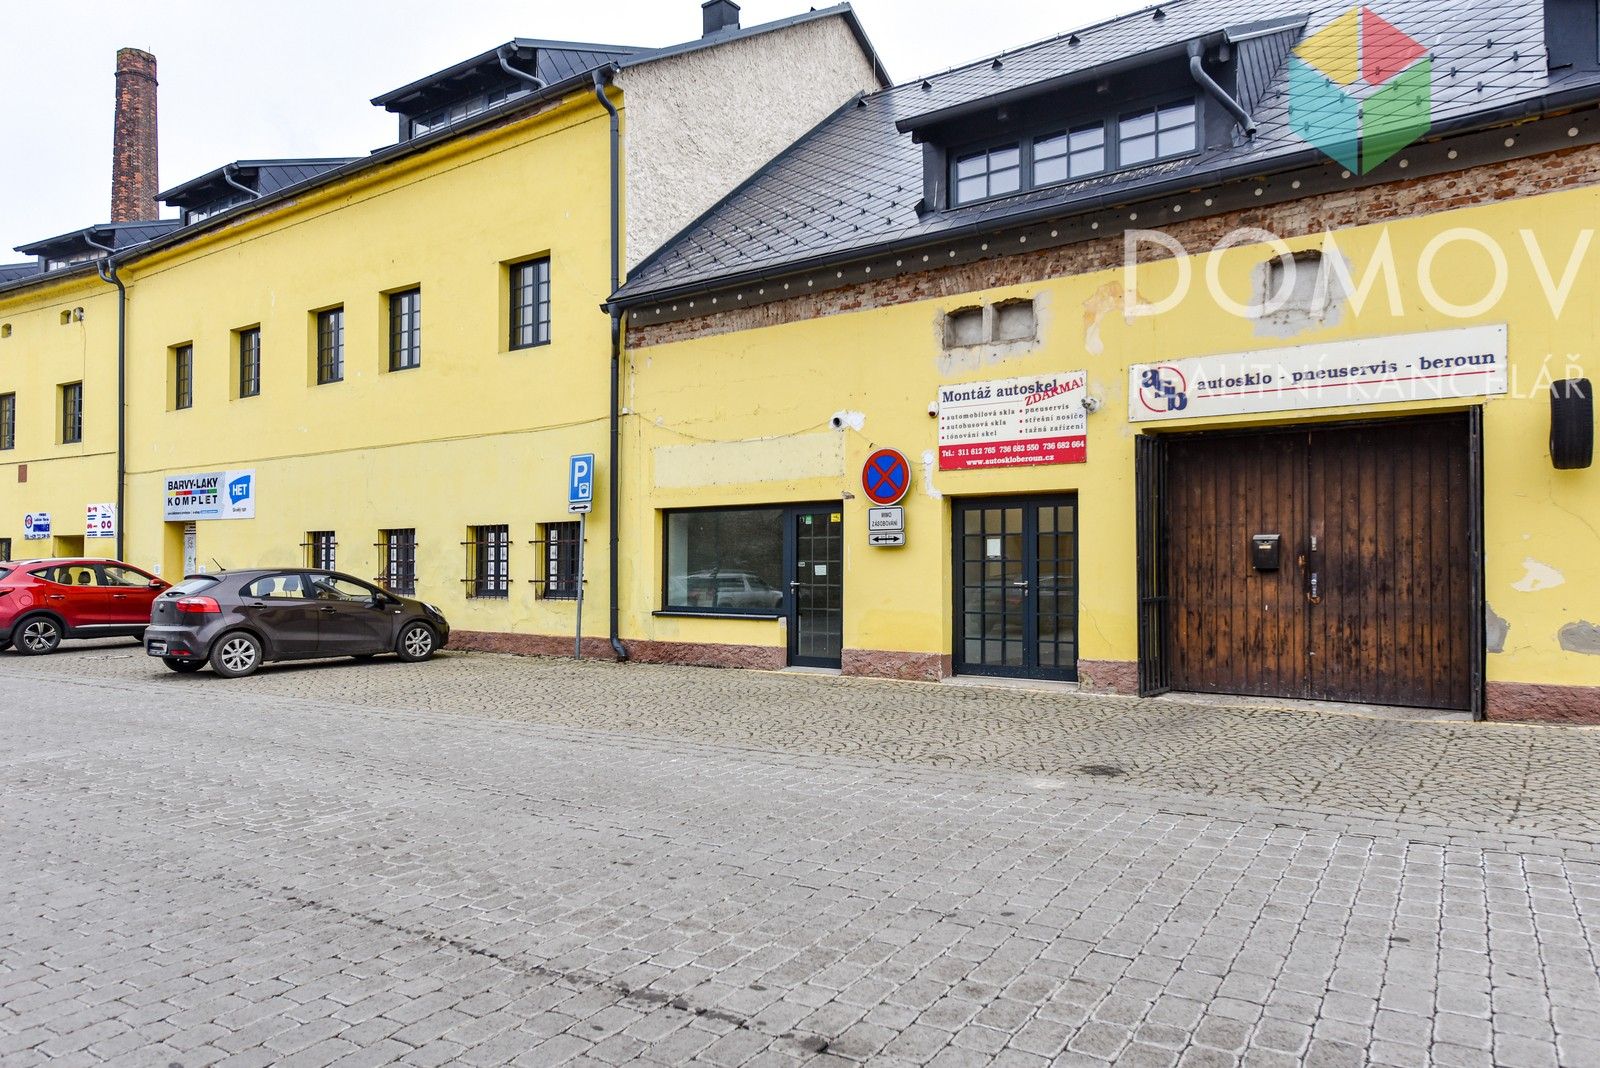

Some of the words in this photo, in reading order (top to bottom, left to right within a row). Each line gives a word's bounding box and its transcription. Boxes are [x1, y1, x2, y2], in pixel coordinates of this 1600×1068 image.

[1197, 370, 1272, 390] autosklo
[1292, 360, 1398, 386] pneuservis
[1420, 350, 1496, 370] beroun
[942, 386, 991, 403] Montáž
[996, 379, 1057, 397] autoskel
[1025, 377, 1084, 406] ZDARMA!
[946, 411, 996, 421] automobilová
[999, 408, 1015, 416] skla
[1025, 403, 1069, 414] pneuservis
[1025, 416, 1053, 424] střešní
[1057, 412, 1084, 421] nosiče
[946, 420, 988, 430] autobusová
[1050, 423, 1084, 432] zařízení
[946, 430, 979, 440] tónování
[981, 430, 997, 438] skel
[958, 447, 969, 456] 311
[971, 447, 982, 455] 612
[966, 454, 1055, 466] www.autoskloberoun.cz
[574, 460, 588, 488] P
[232, 484, 247, 496] HET
[168, 495, 218, 506] KOMPLET
